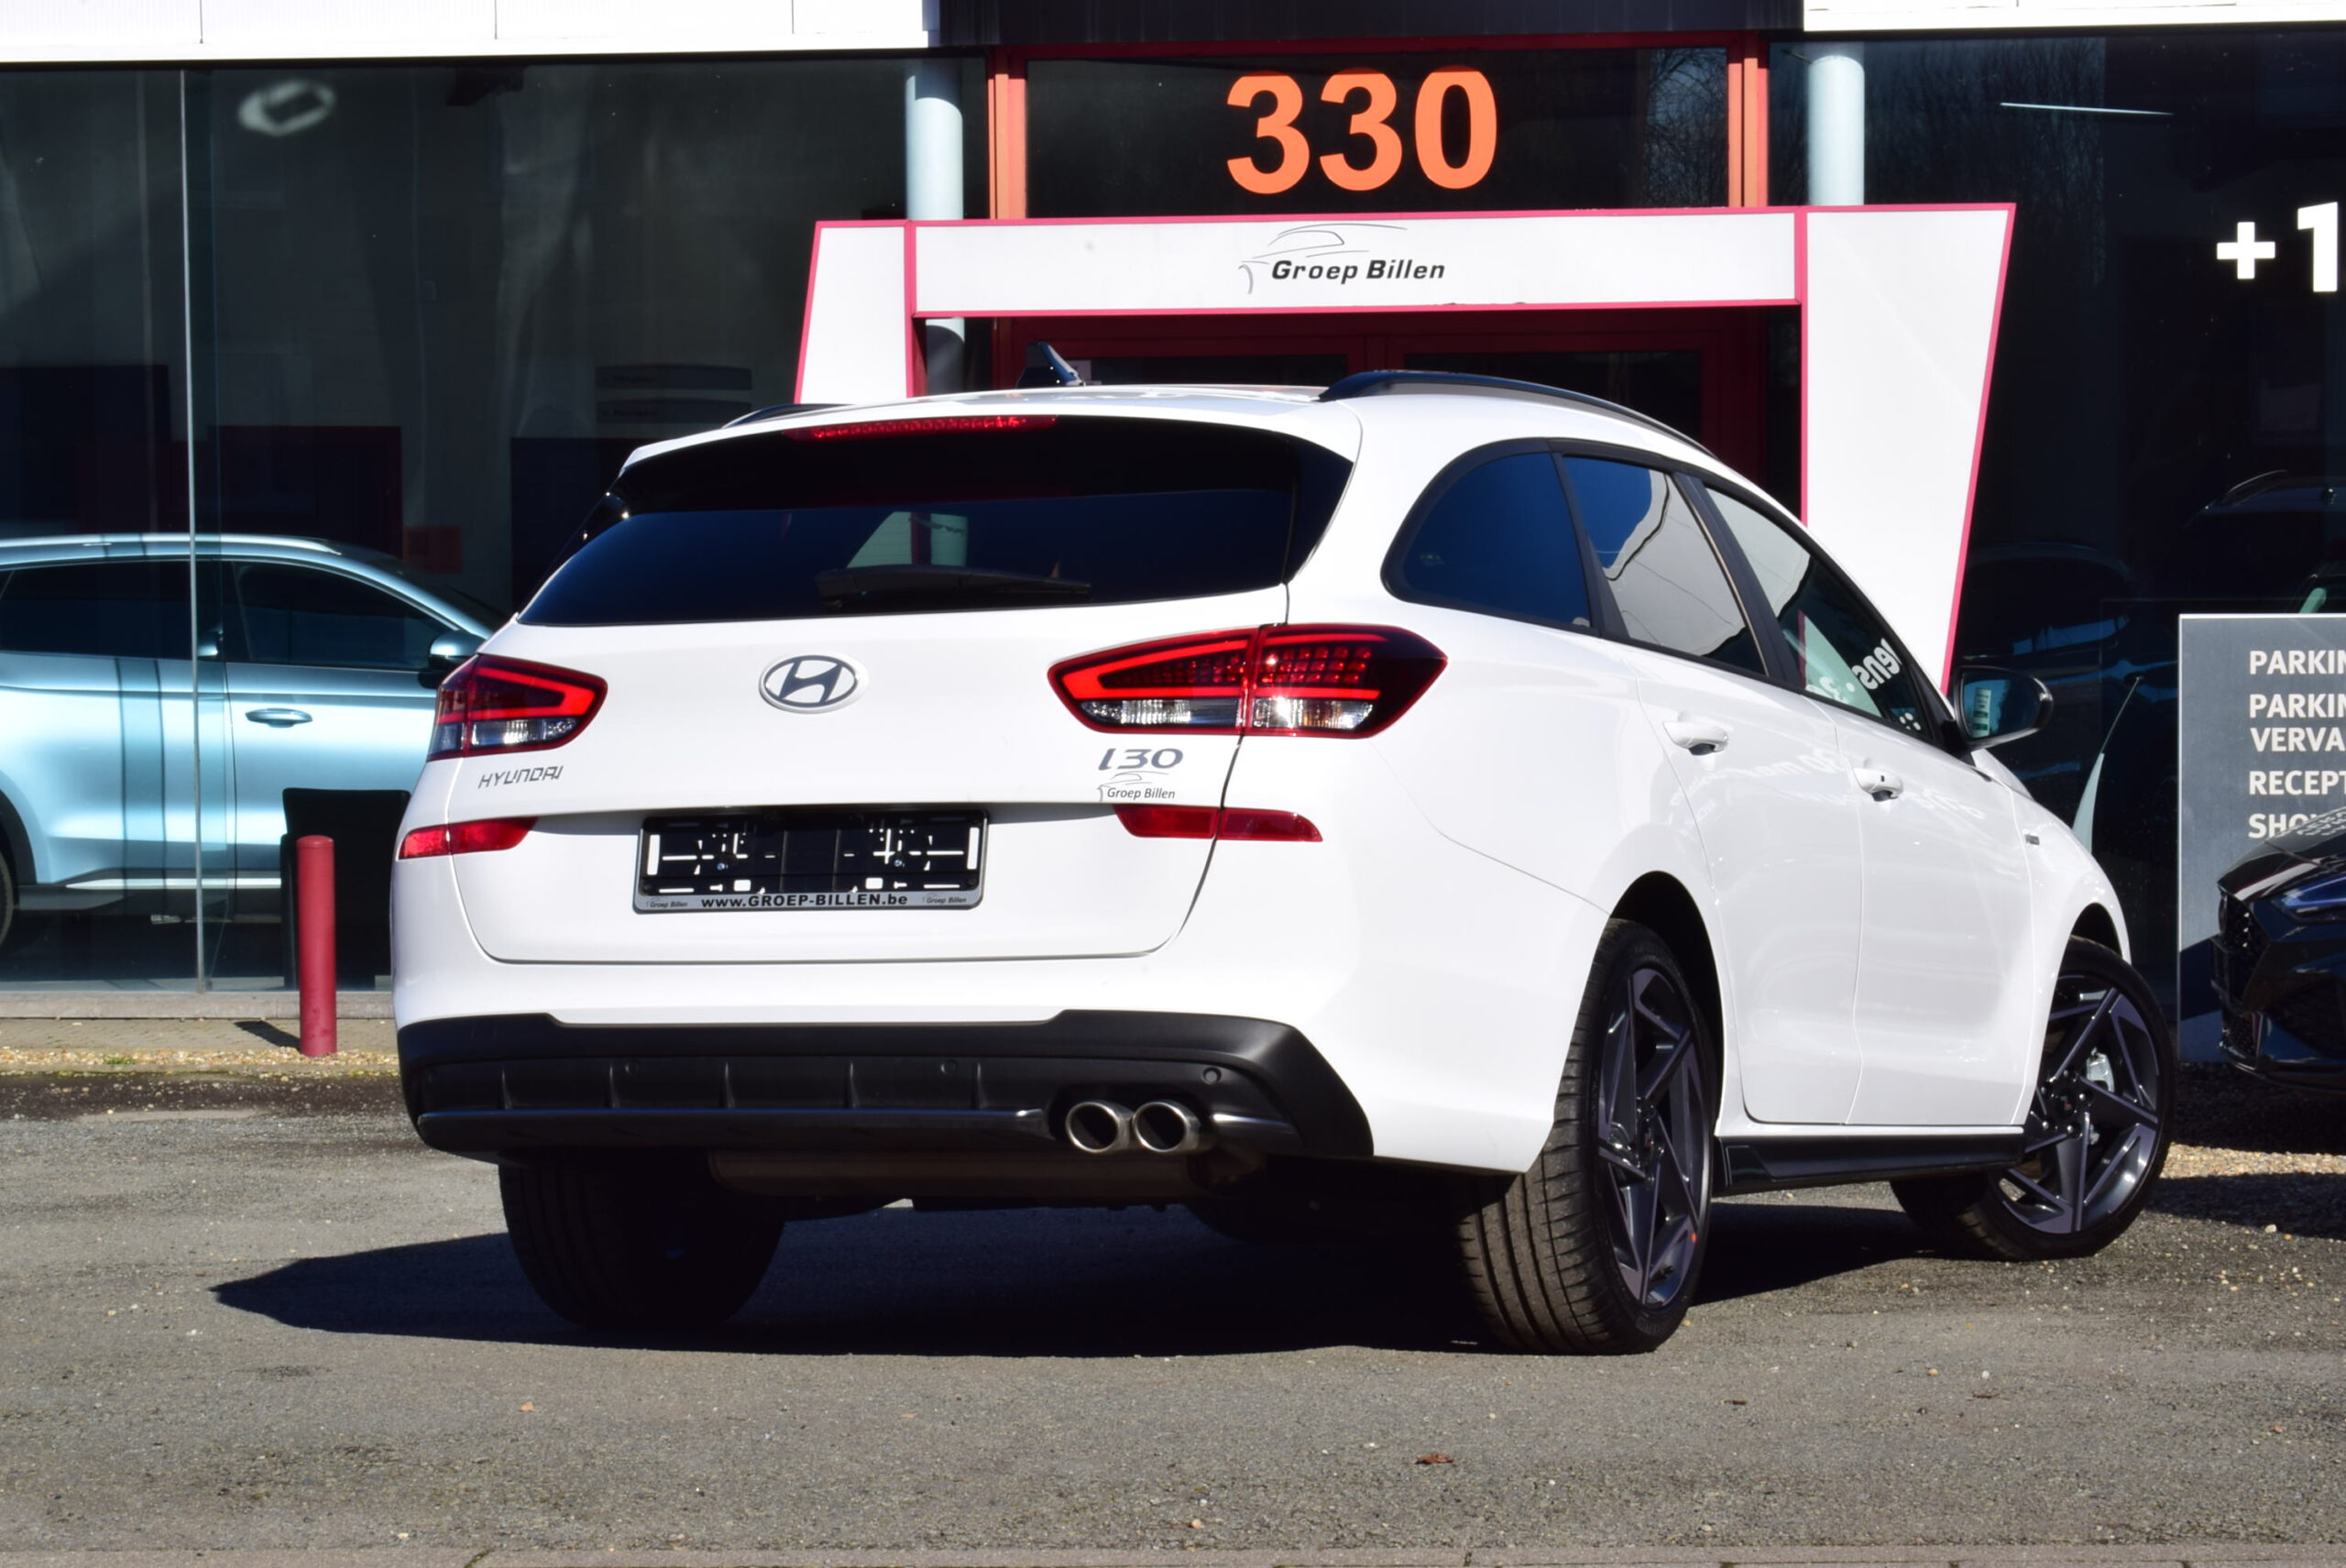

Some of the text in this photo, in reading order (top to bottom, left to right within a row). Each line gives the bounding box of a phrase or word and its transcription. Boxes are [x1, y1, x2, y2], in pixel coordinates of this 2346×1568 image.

[1227, 66, 1497, 194] 330
[1272, 259, 1445, 284] Groep Billen
[477, 765, 564, 789] HYUNDAI
[1107, 787, 1176, 801] Groep Billen
[701, 894, 908, 907] www.GROEP-BILLEN.be
